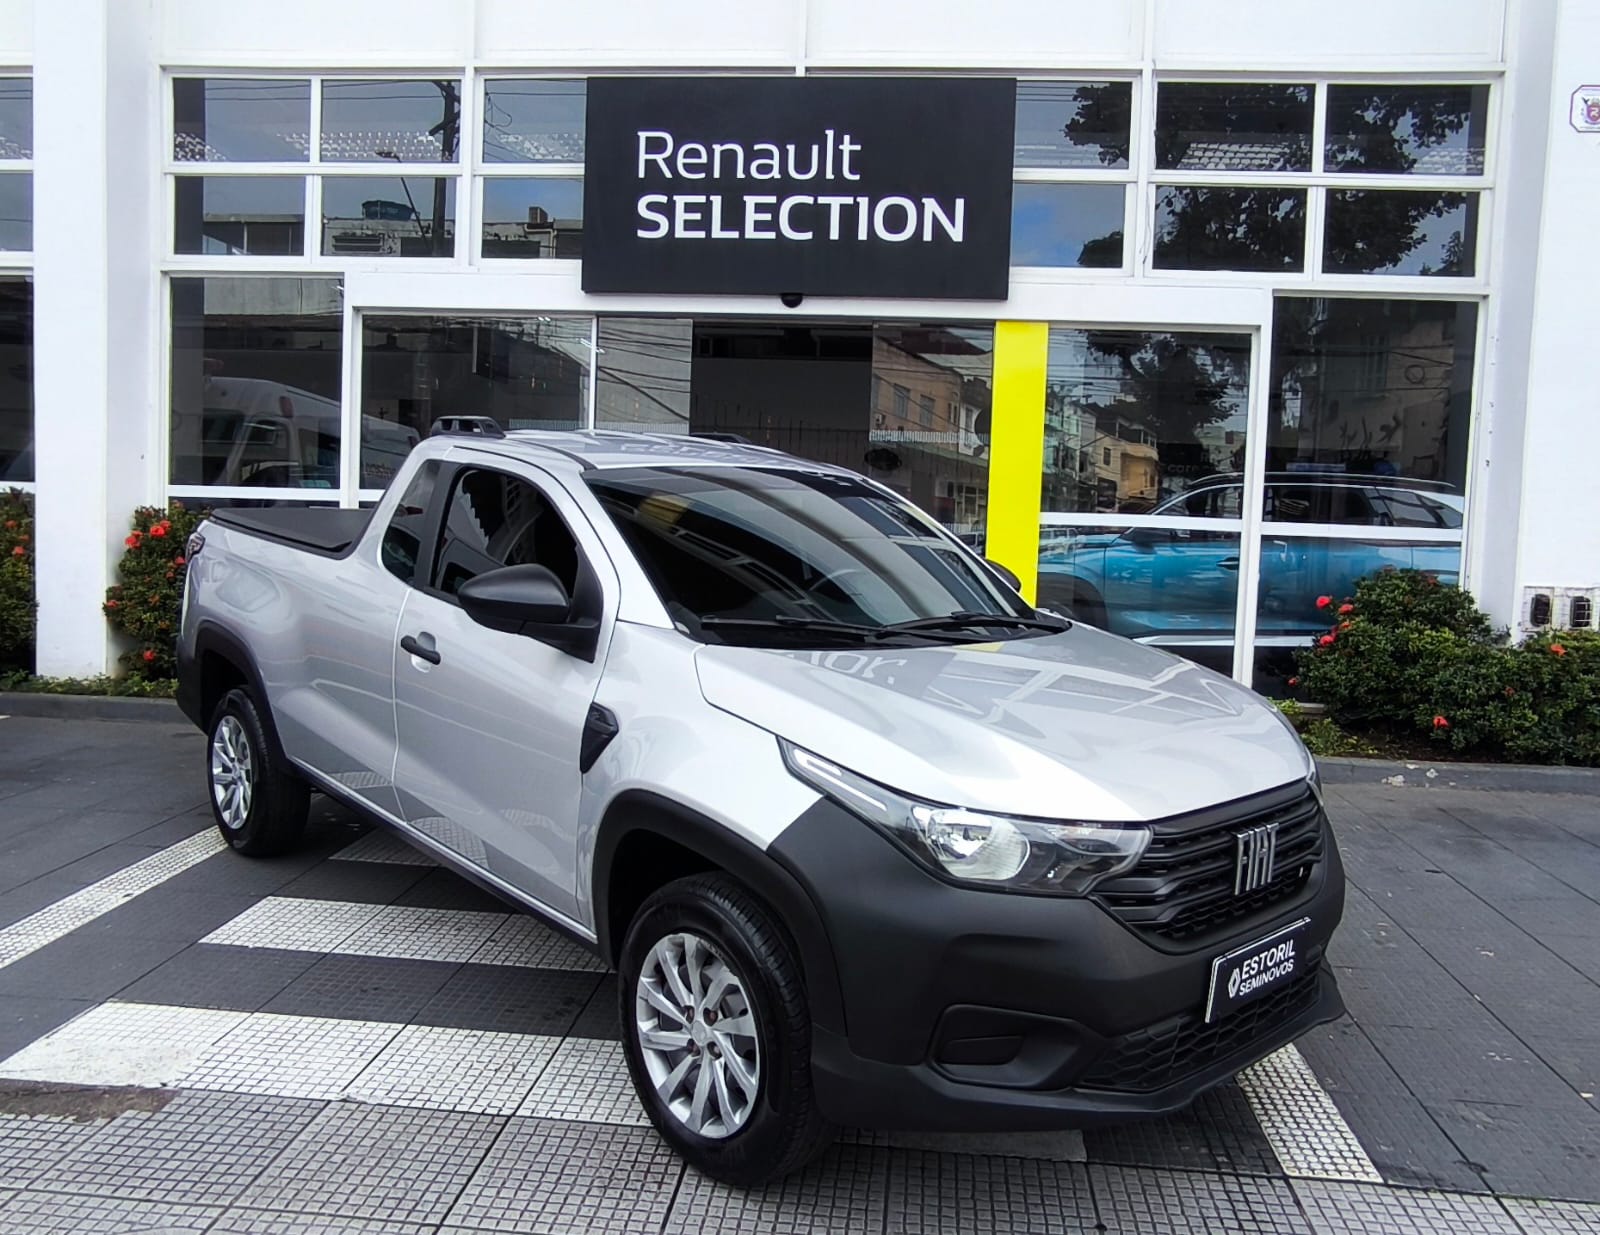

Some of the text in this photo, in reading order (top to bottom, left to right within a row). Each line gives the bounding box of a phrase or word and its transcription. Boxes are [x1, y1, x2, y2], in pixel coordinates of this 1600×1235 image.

[636, 130, 861, 181] Renault
[636, 194, 965, 243] SELECTION
[1235, 822, 1280, 896] FIAT
[1239, 960, 1295, 996] SEMINOVOS
[1241, 939, 1296, 980] ESTORIL
